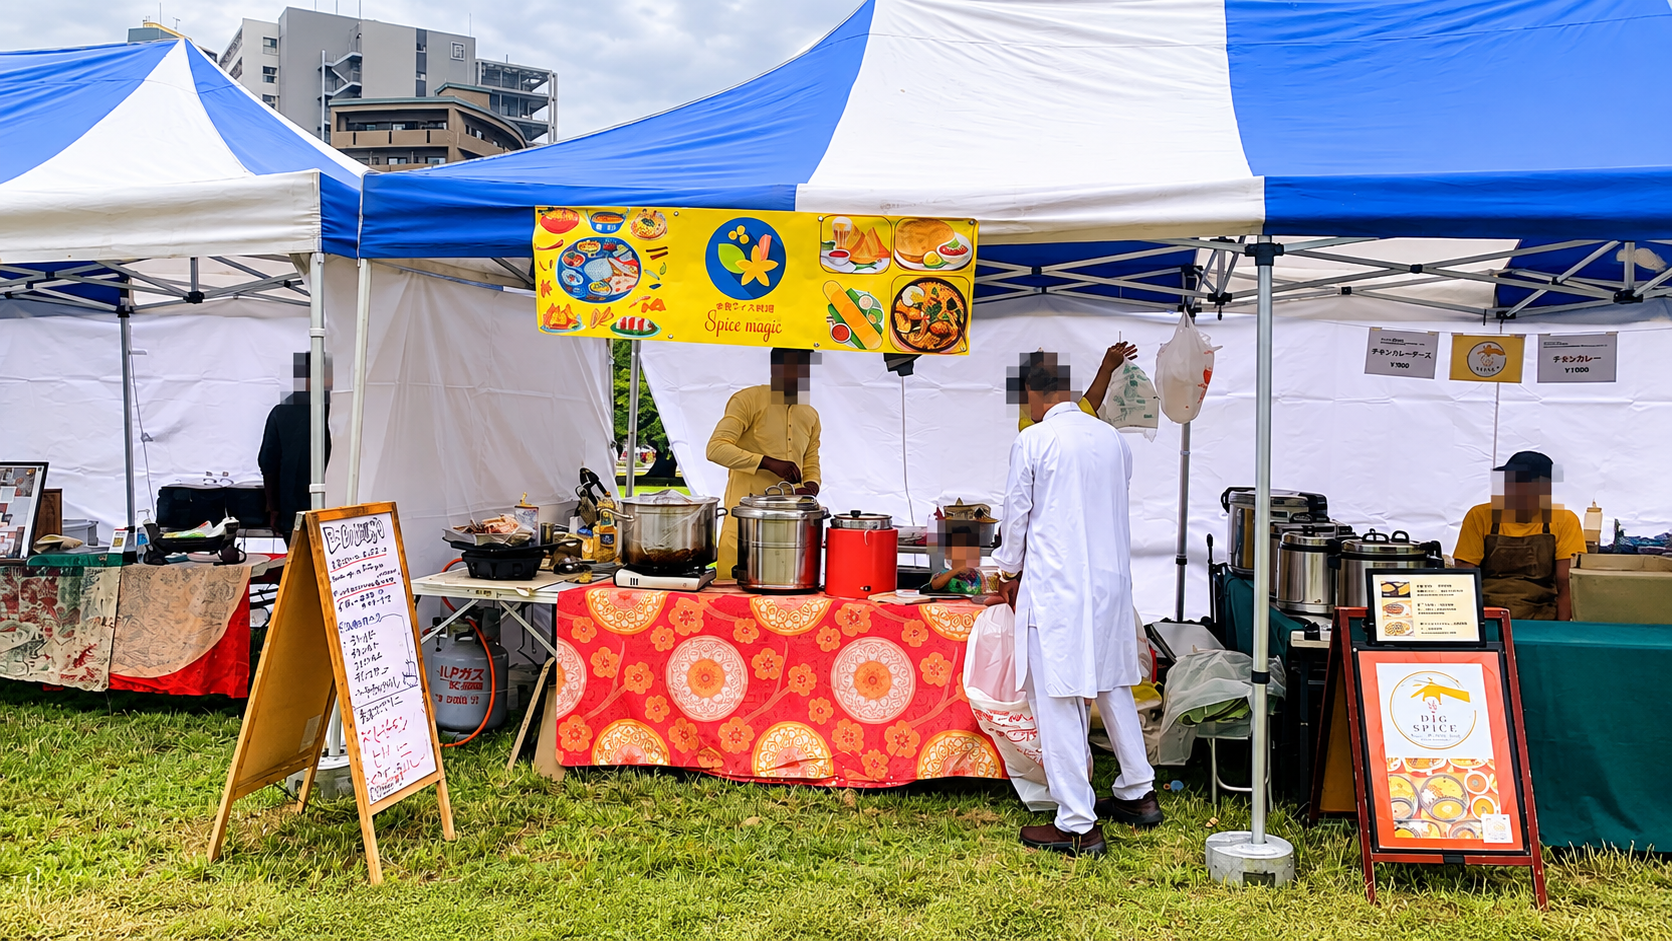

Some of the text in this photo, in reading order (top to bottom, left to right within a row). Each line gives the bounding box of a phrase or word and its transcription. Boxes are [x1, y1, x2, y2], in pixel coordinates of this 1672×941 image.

[704, 309, 782, 342] Spice magic
[1421, 714, 1447, 723] DIG
[1413, 724, 1458, 733] SPICE
